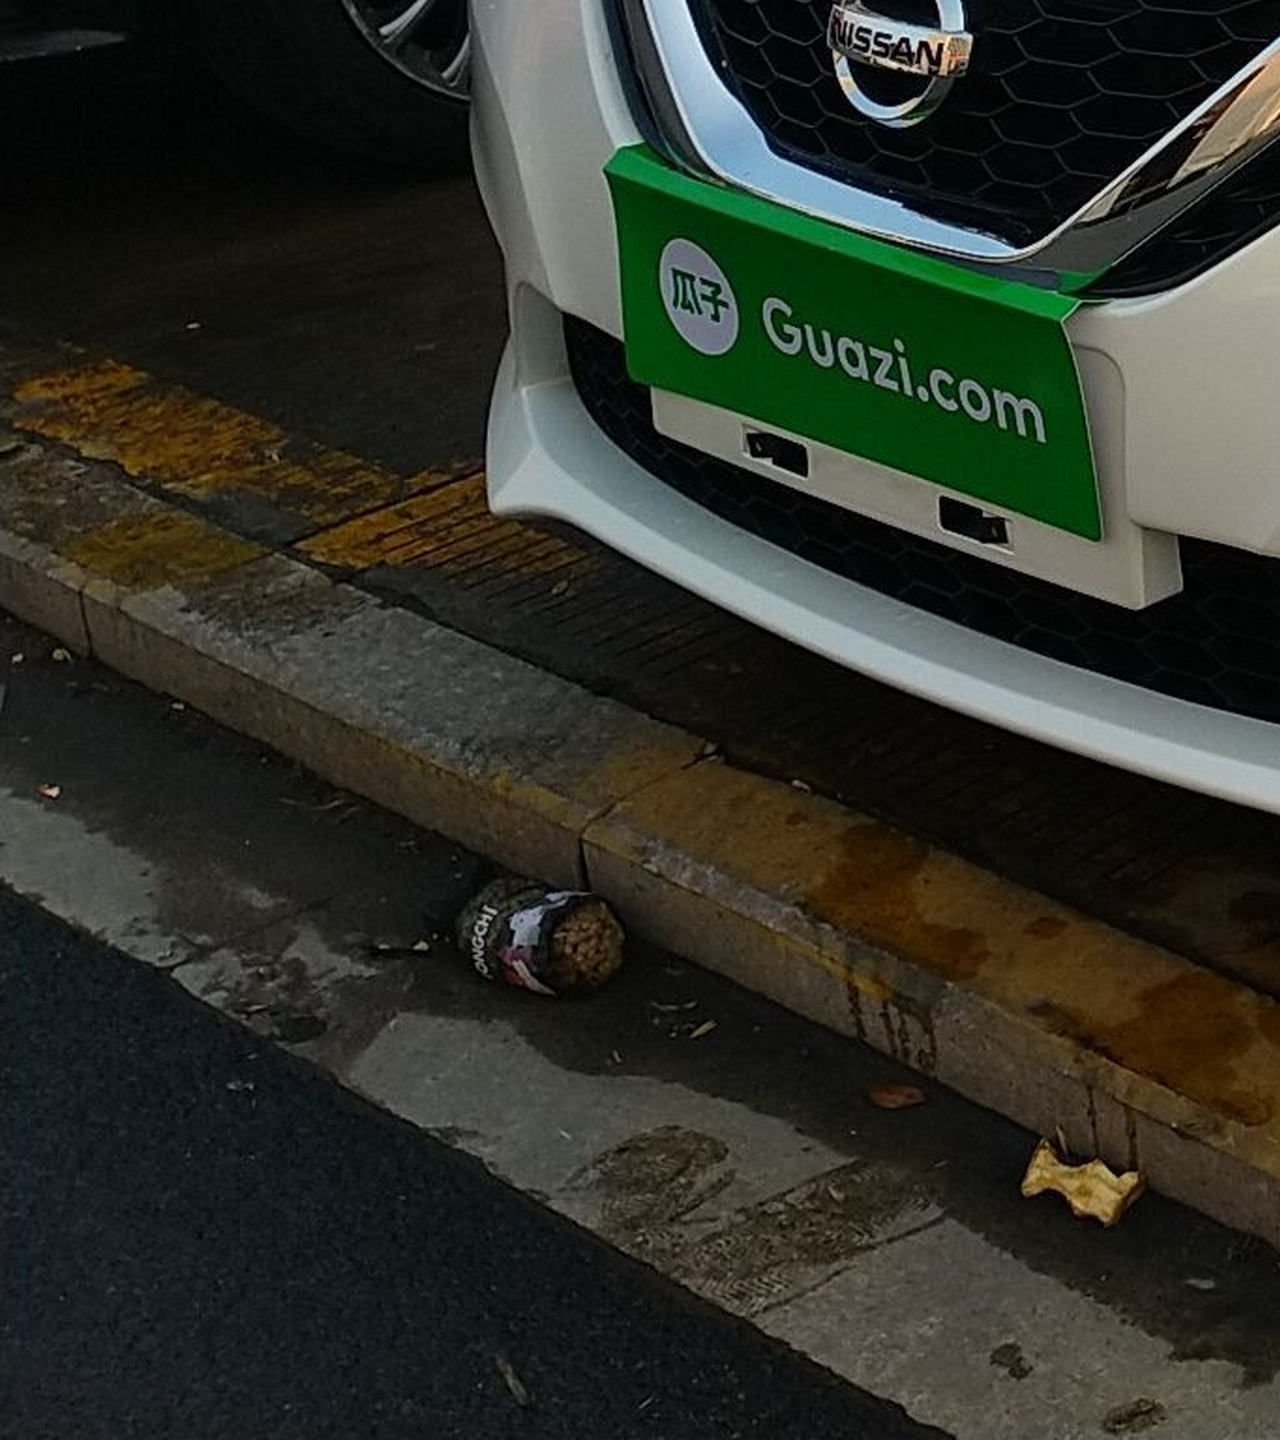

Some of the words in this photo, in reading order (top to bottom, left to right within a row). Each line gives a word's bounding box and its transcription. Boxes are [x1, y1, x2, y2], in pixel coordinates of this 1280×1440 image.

[830, 10, 945, 69] NISSAN
[671, 267, 730, 323] 瓜子
[762, 297, 1047, 444] Guazi.com
